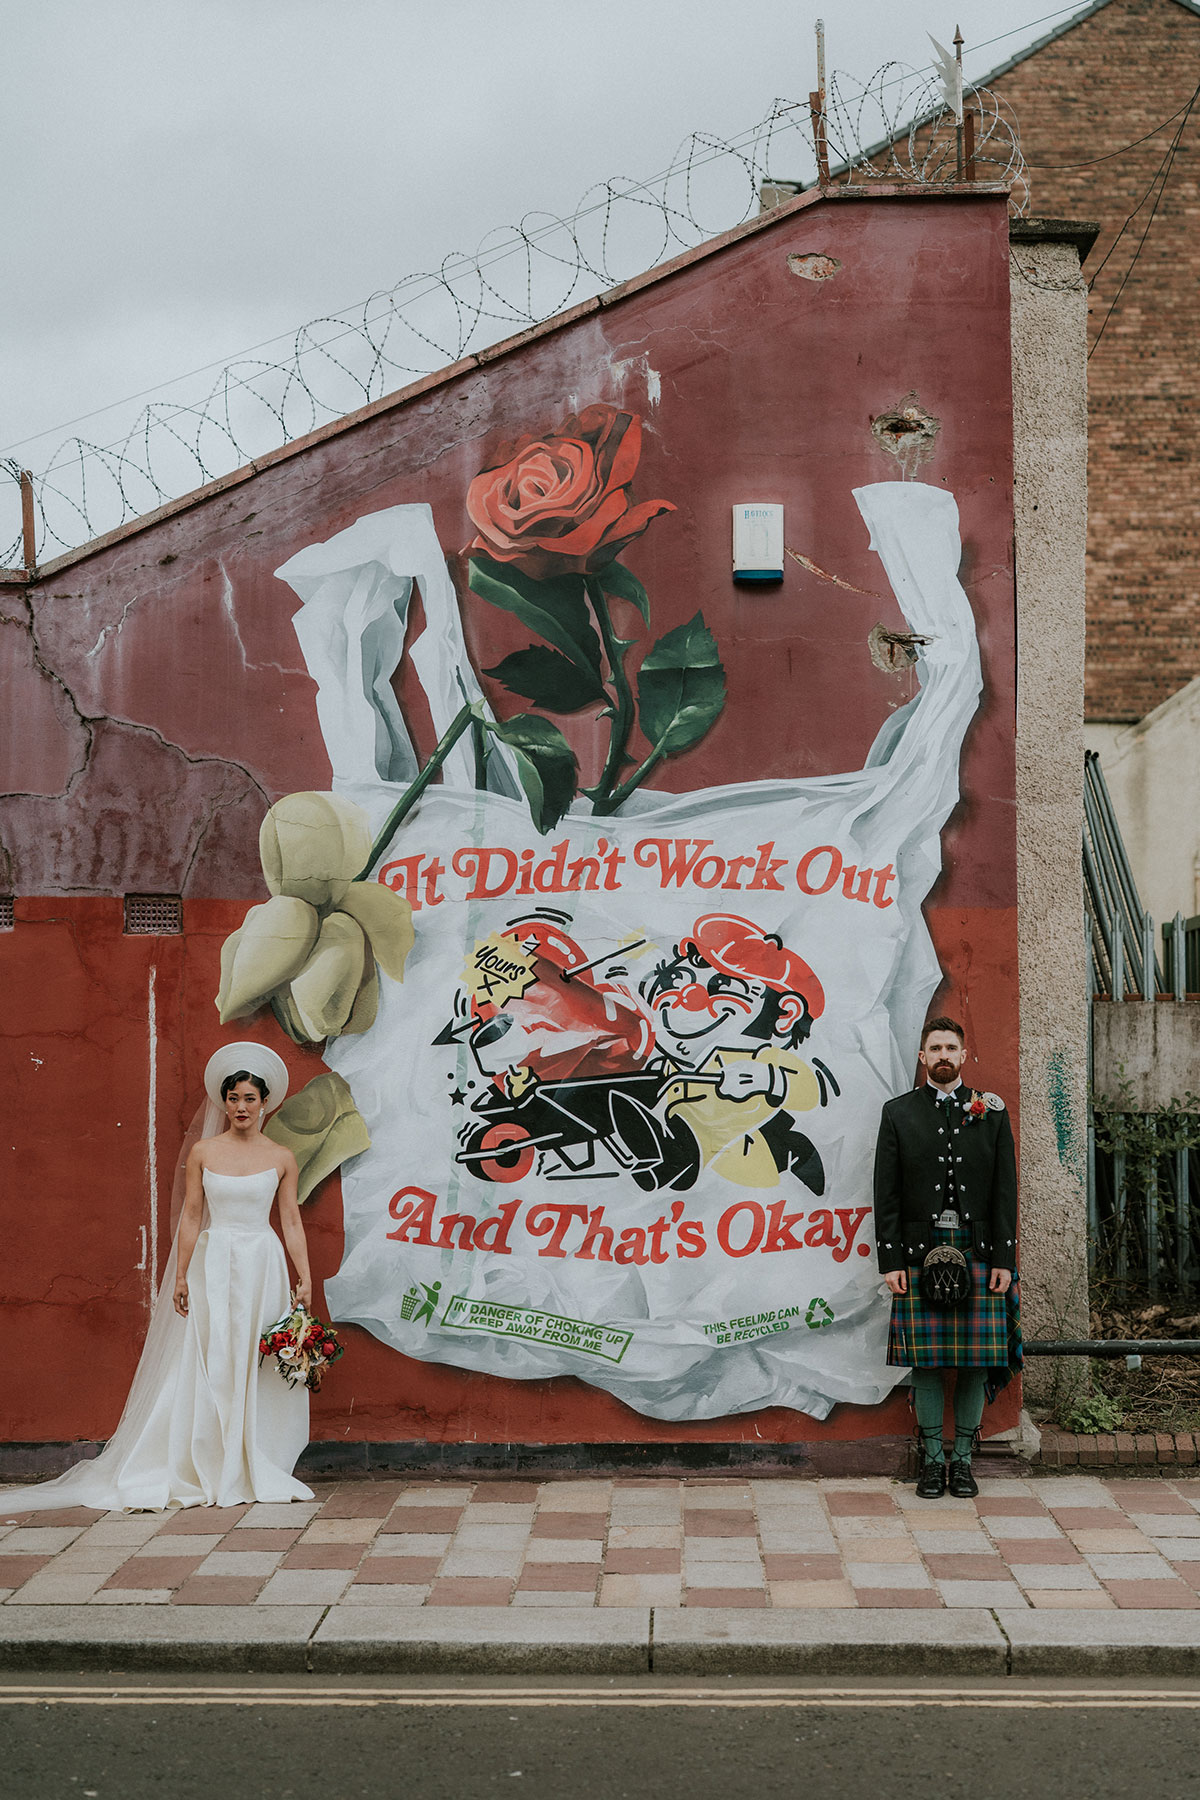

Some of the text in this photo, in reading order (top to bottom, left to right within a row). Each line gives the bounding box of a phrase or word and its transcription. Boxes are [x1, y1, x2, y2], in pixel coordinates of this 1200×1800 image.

[378, 838, 897, 911] It Didn't Work Out
[474, 946, 525, 982] Yours
[387, 1185, 872, 1264] And That's Okay.
[454, 1302, 624, 1345] IN DANGER OF CHOKING UP
[469, 1315, 603, 1351] KEEP AWAY FROM ME
[703, 1306, 799, 1335] THIS FEELING CAN
[717, 1320, 790, 1345] BE RECYCLED
